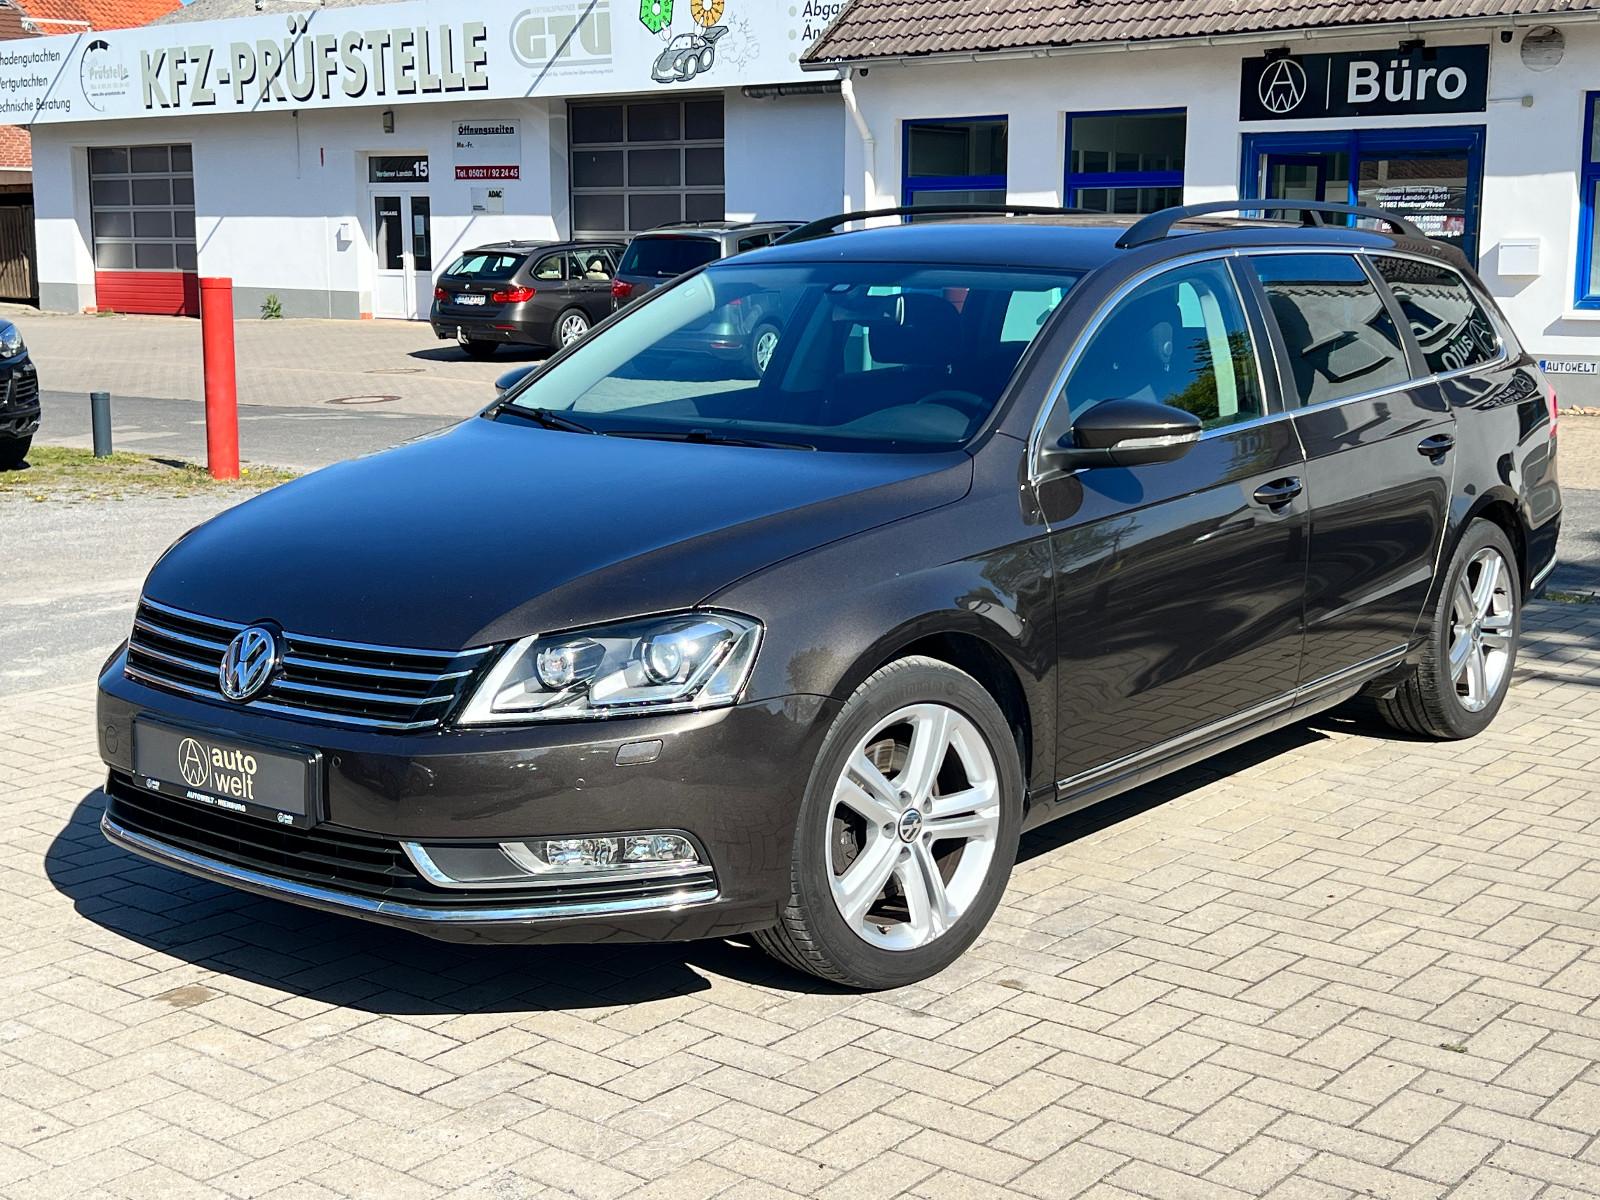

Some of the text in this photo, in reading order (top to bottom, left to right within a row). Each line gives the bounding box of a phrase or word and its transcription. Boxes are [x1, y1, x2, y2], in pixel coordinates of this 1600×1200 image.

[140, 13, 489, 109] KFZ-PRÜFSTELLE
[0, 73, 48, 92] ertgutachten
[1347, 58, 1468, 104] Büro
[36, 97, 71, 112] Beratung
[458, 123, 515, 135] Öffnungszeiten
[413, 161, 428, 177] 15
[456, 169, 468, 178] Tel.
[469, 169, 487, 177] 05021
[492, 169, 499, 177] 92
[500, 169, 508, 177] 24
[509, 169, 518, 177] 45
[488, 190, 502, 198] ADAC
[1546, 361, 1597, 373] AUTOWELT
[211, 747, 257, 775] auto
[214, 772, 254, 800] welt
